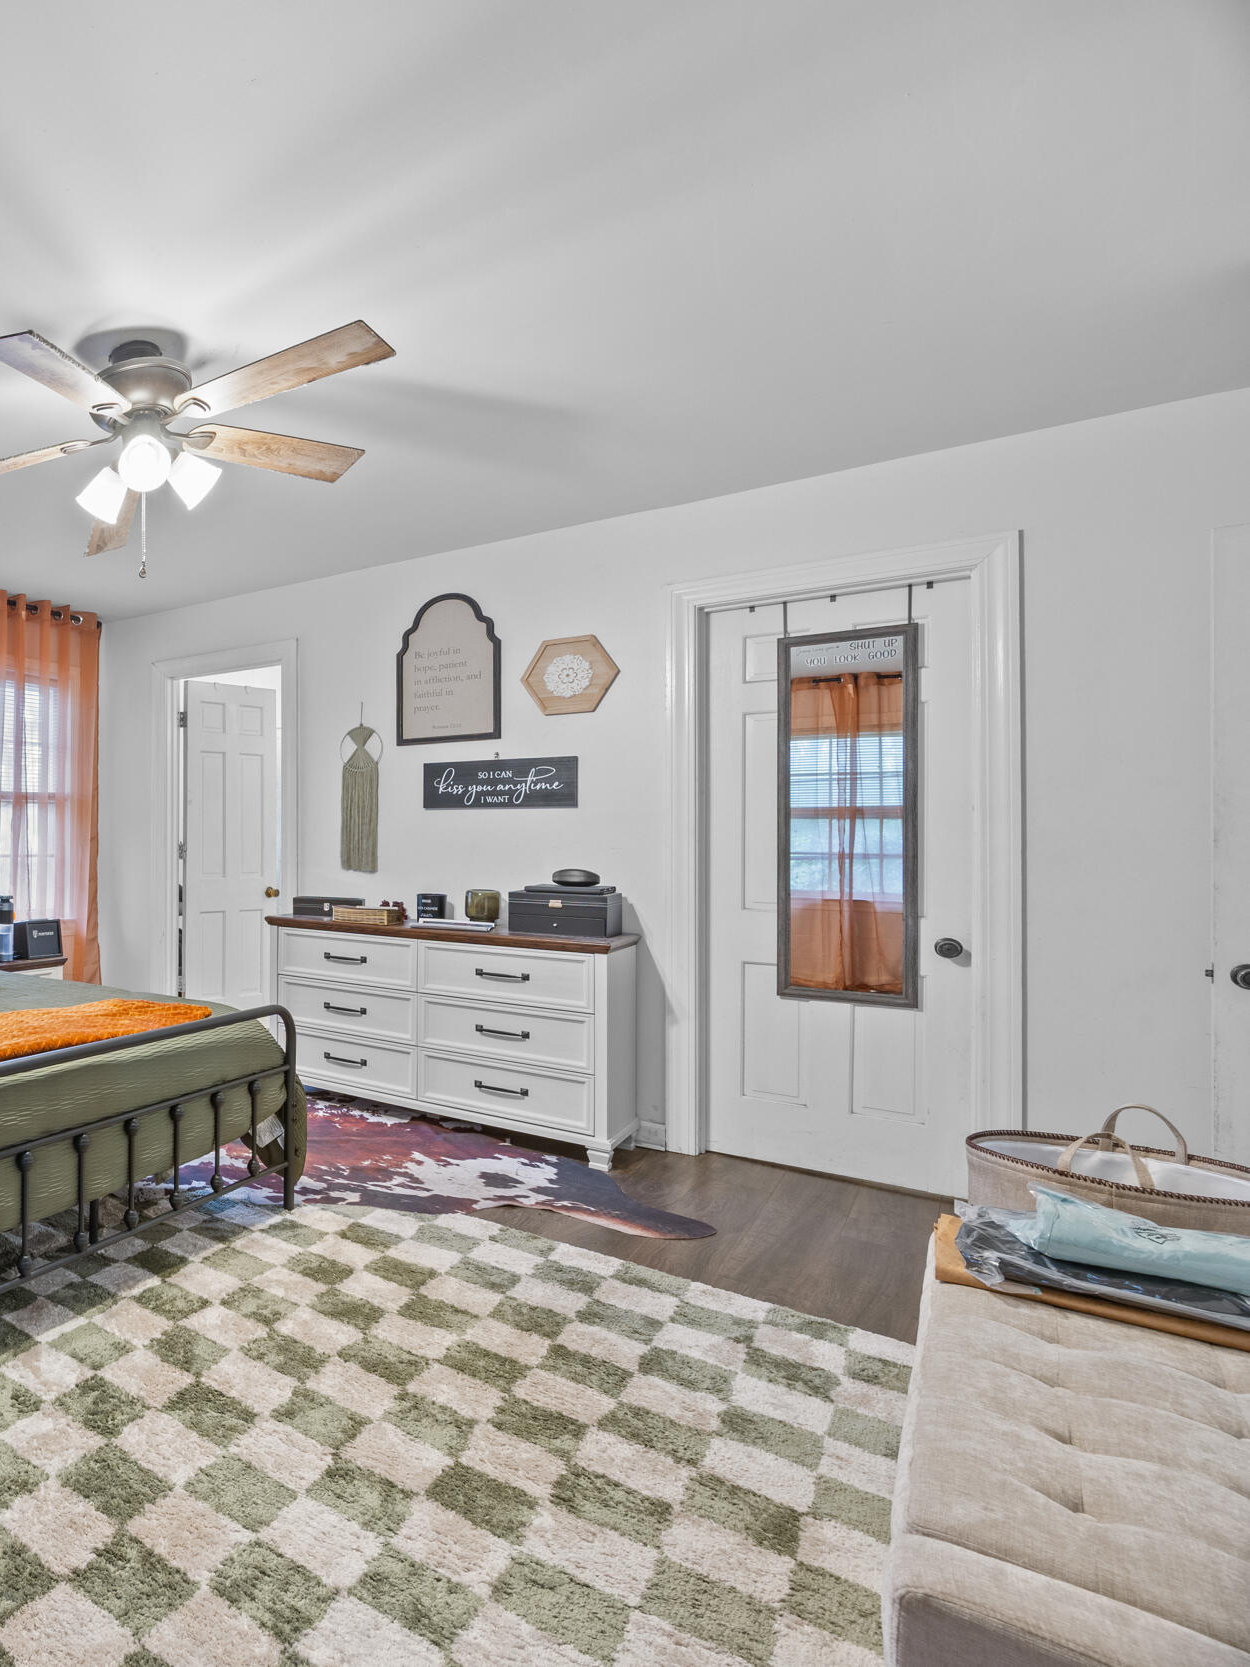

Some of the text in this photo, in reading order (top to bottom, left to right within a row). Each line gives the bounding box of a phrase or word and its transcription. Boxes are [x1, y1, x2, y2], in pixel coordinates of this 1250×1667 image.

[850, 641, 876, 651] SHUT
[884, 638, 898, 647] UP
[806, 649, 897, 667] YOU LOOK GOOD
[494, 770, 512, 778] CAN
[434, 766, 564, 805] kiss you anytime
